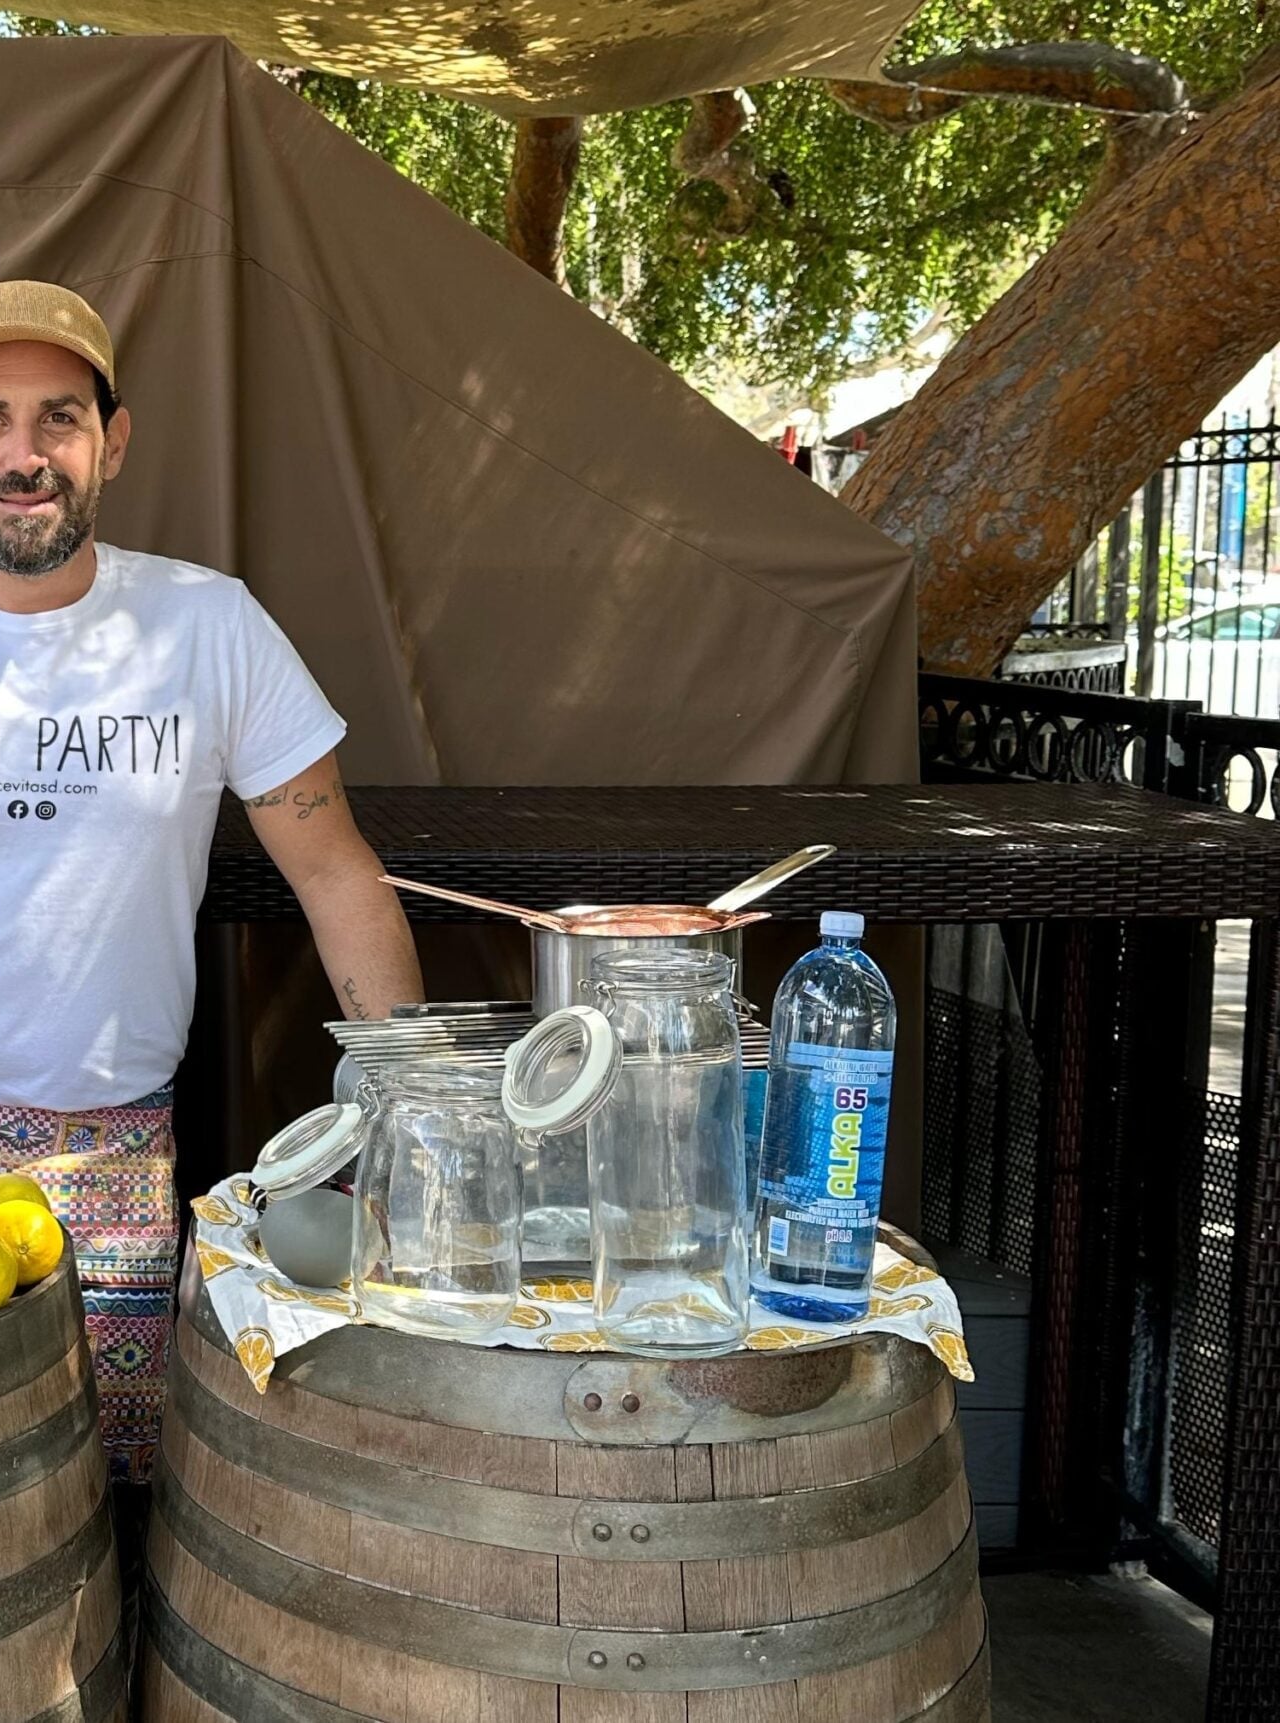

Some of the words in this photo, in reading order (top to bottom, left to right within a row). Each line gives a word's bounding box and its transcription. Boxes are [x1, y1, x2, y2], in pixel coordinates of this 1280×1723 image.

[36, 714, 180, 775] PARTY!
[834, 1086, 868, 1111] 65
[827, 1112, 863, 1199] ALKA
[825, 1229, 838, 1244] pH
